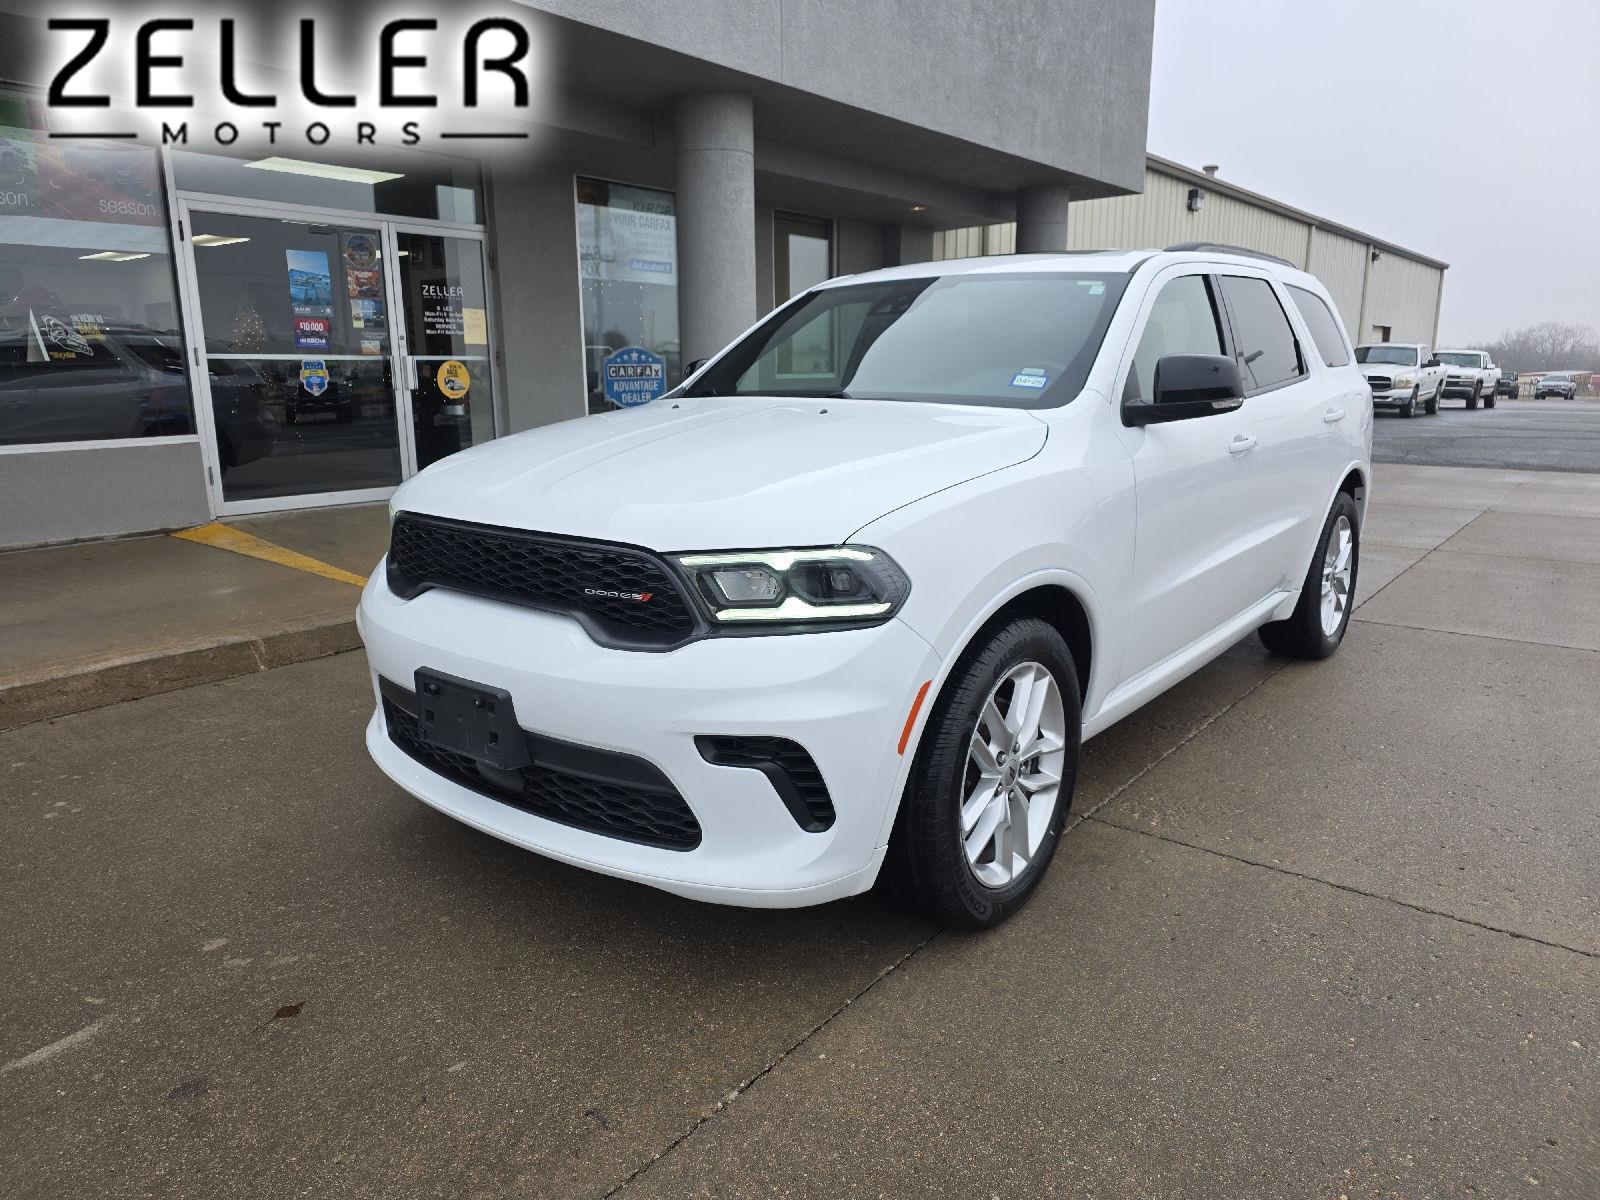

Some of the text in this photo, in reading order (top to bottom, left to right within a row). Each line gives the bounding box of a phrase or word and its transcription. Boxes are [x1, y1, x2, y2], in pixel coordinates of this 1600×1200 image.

[99, 199, 161, 217] season.
[633, 201, 671, 216] YOUR CAR
[614, 214, 671, 231] YOUR CARFAX
[422, 285, 464, 297] ZELLER
[609, 365, 660, 377] CARFAX
[613, 380, 659, 392] ADVANTAGE
[621, 392, 652, 403] DEALER
[584, 588, 642, 600] DODGE
